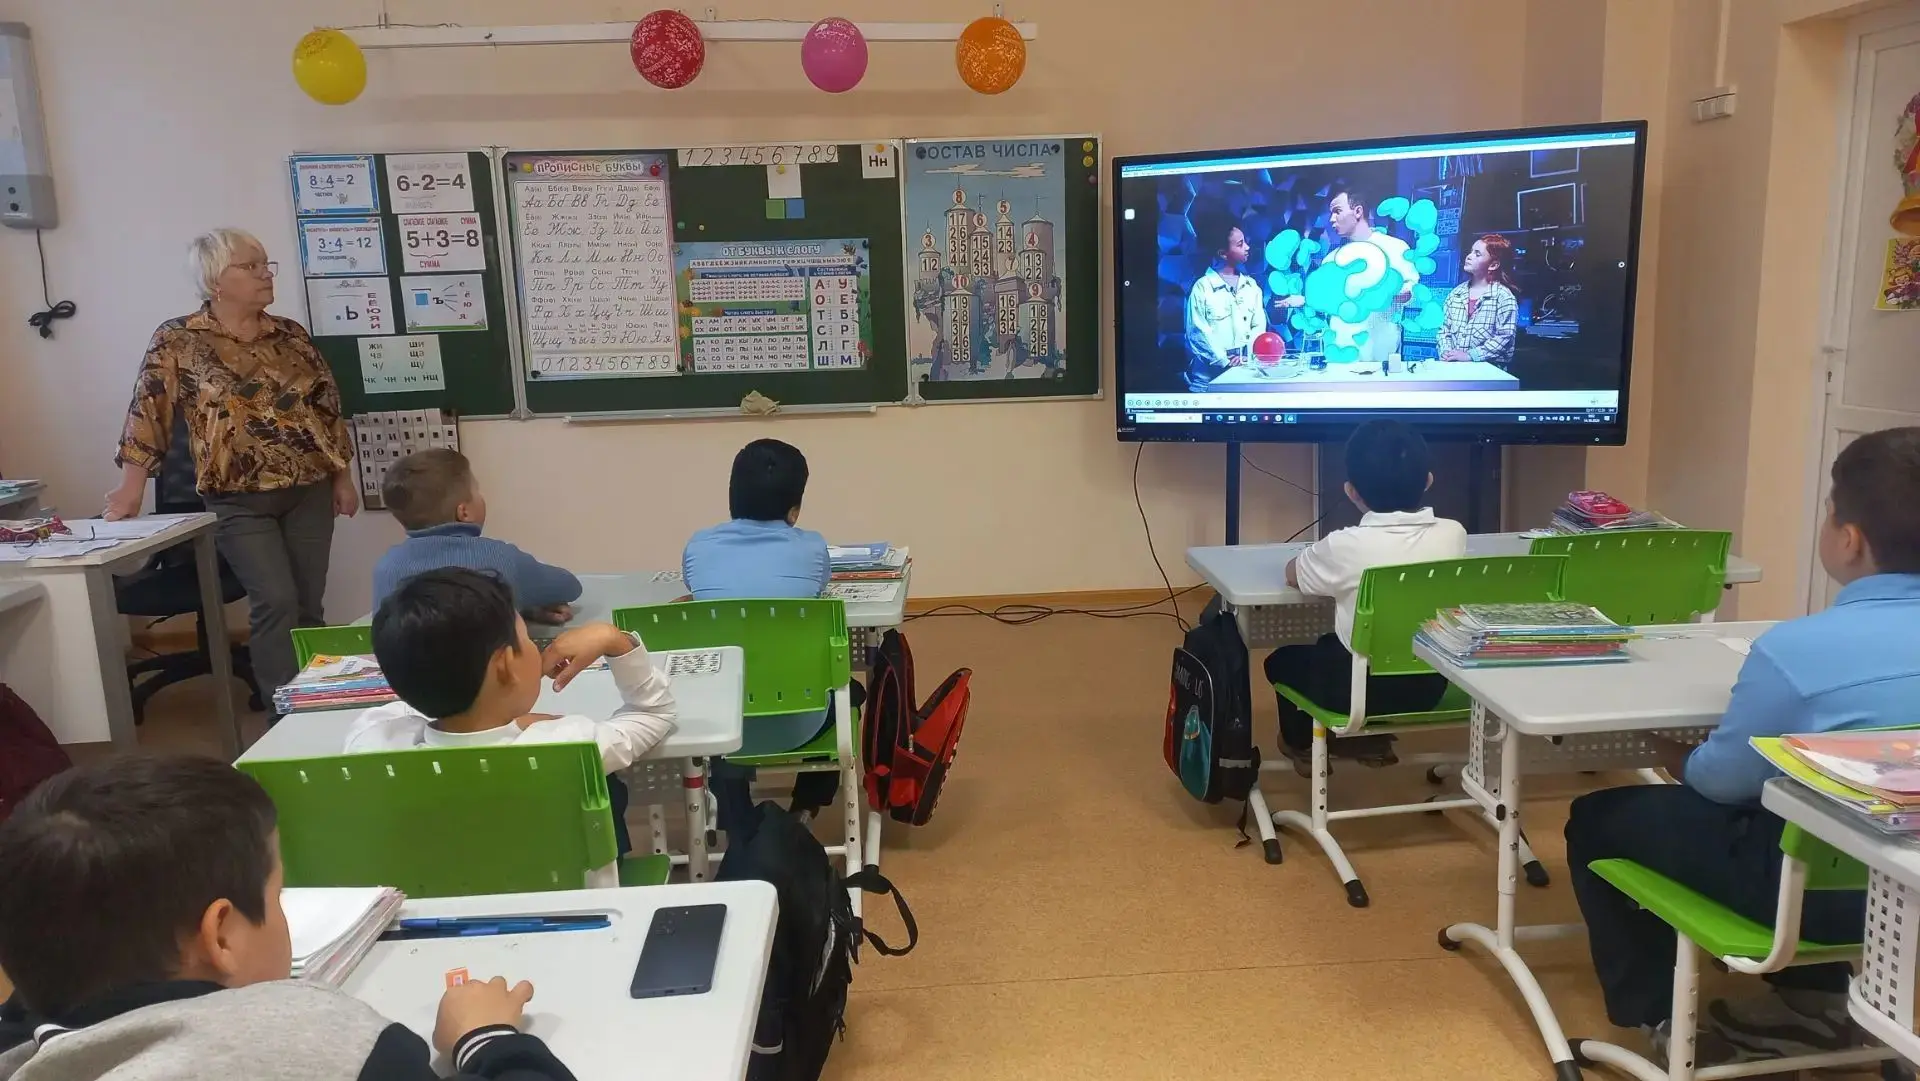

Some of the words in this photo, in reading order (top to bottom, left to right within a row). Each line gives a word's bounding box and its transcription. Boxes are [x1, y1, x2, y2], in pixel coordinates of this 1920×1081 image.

[916, 146, 986, 160] ОСТАВ
[992, 144, 1053, 158] ЧИСЛА
[606, 160, 641, 172] БУКВЫ
[870, 156, 888, 167] Нн
[738, 245, 776, 257] БУКВЫ
